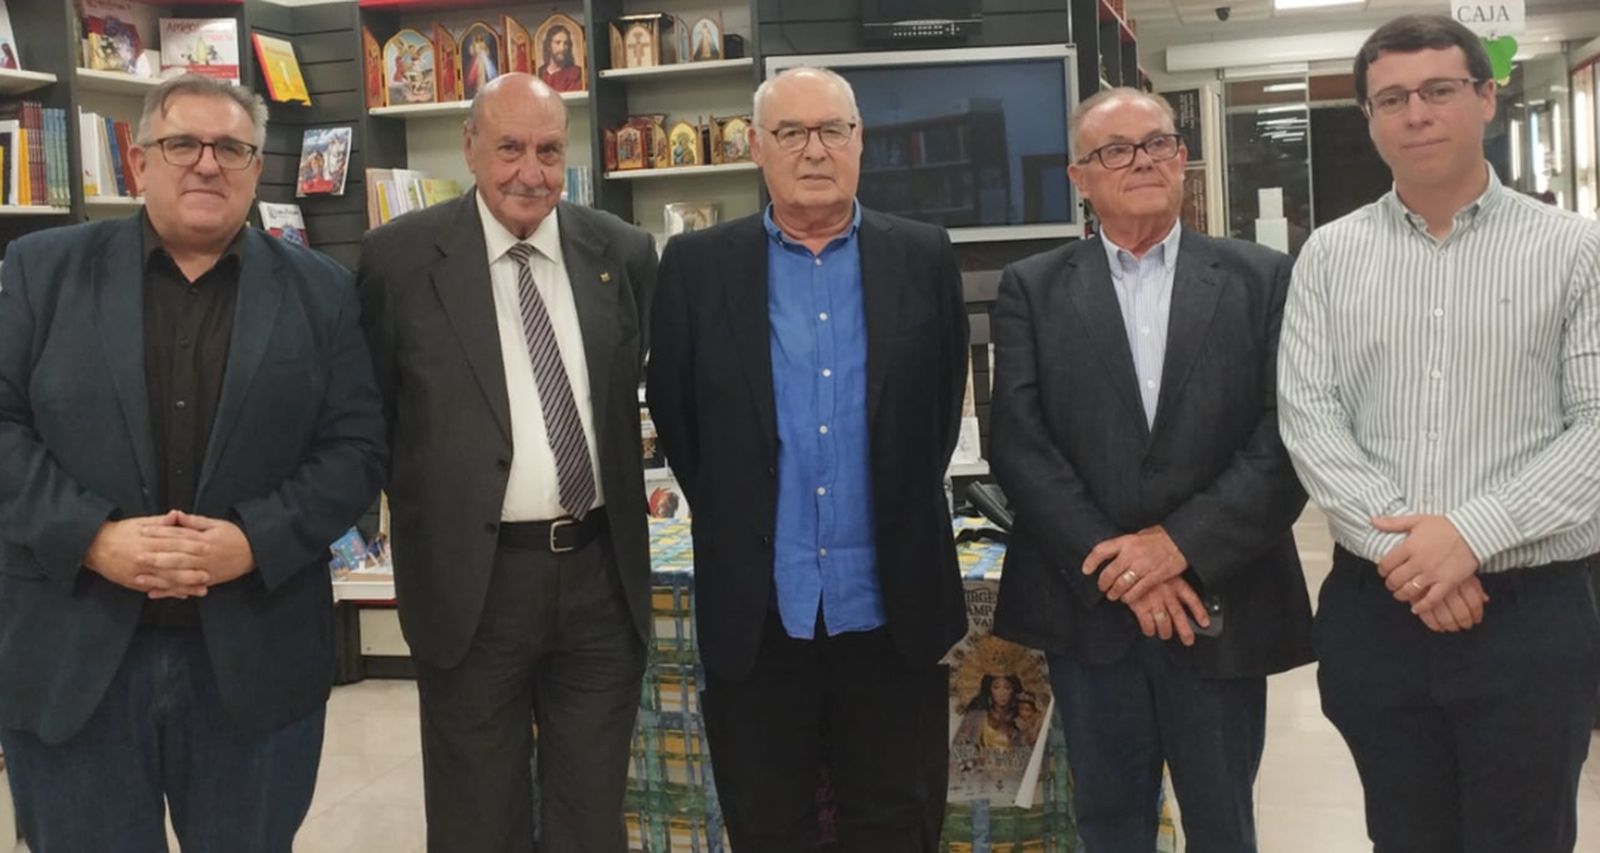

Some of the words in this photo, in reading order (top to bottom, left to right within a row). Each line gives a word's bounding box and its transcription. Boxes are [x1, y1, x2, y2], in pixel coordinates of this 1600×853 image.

[1457, 5, 1509, 22] CAJA
[965, 591, 998, 604] IRGE
[968, 604, 993, 617] AMP
